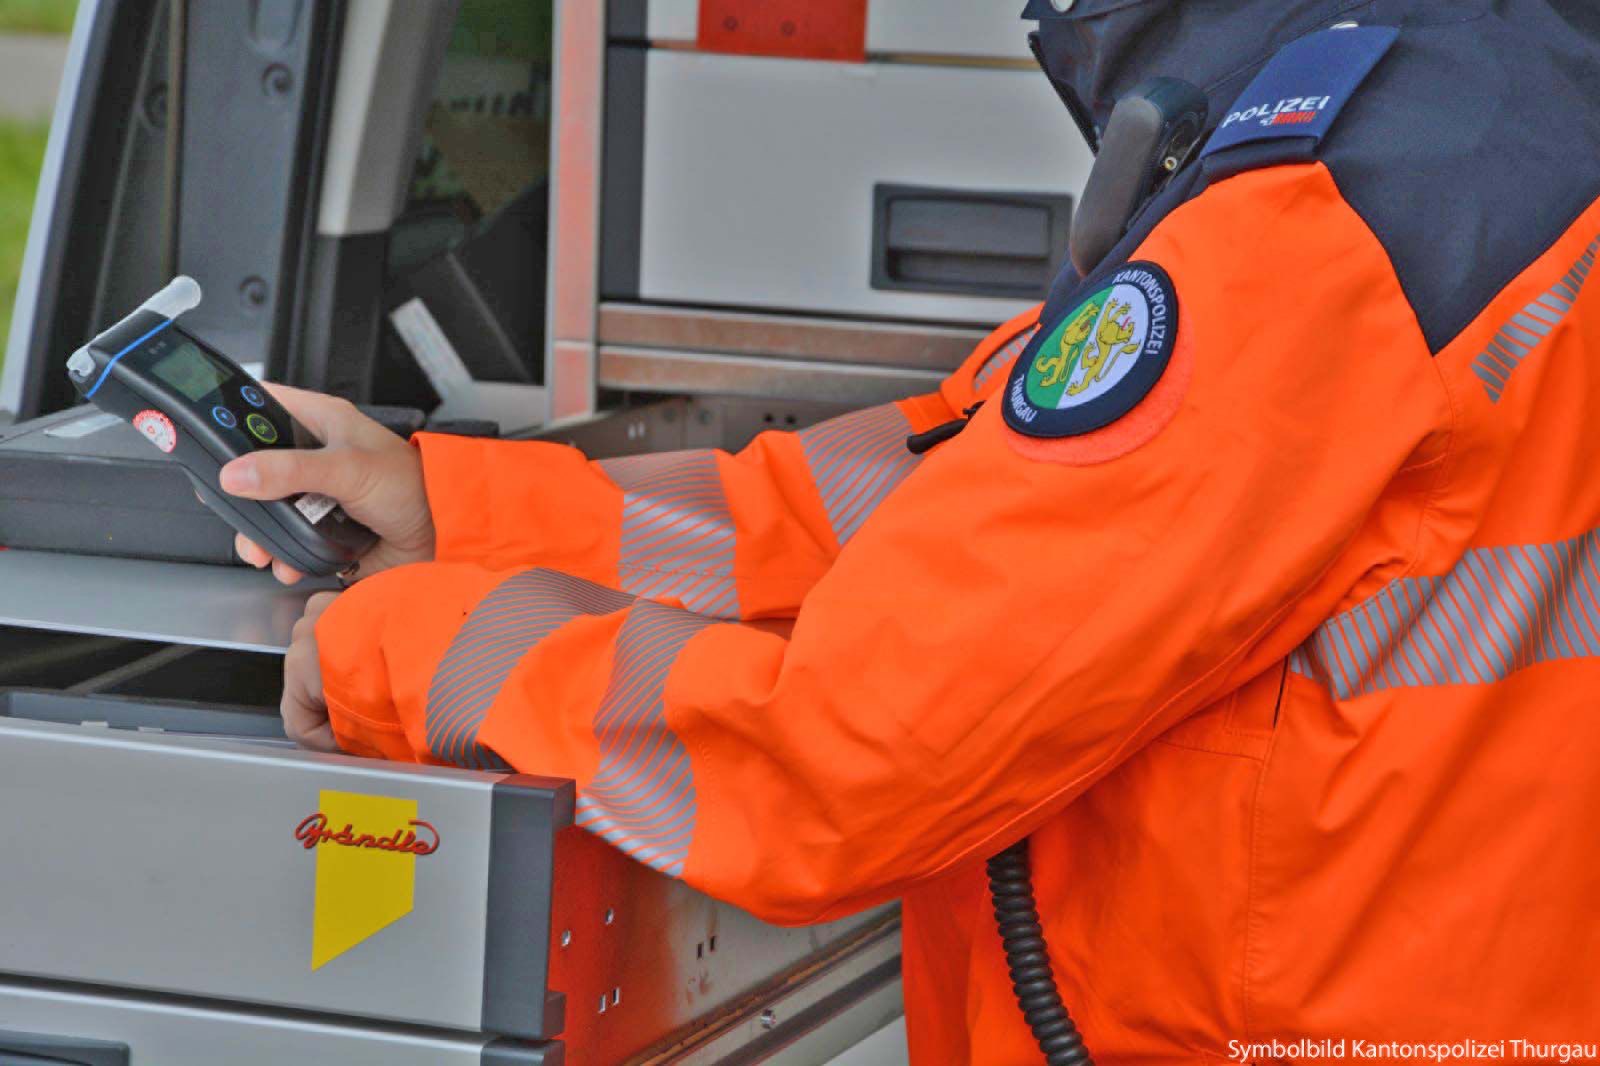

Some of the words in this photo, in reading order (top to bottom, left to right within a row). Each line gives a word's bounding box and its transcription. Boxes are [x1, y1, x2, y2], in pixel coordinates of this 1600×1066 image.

[1221, 95, 1331, 129] POLIZEI
[1112, 269, 1167, 355] KANTONSPOLIZEI
[1010, 373, 1038, 423] THURGAU
